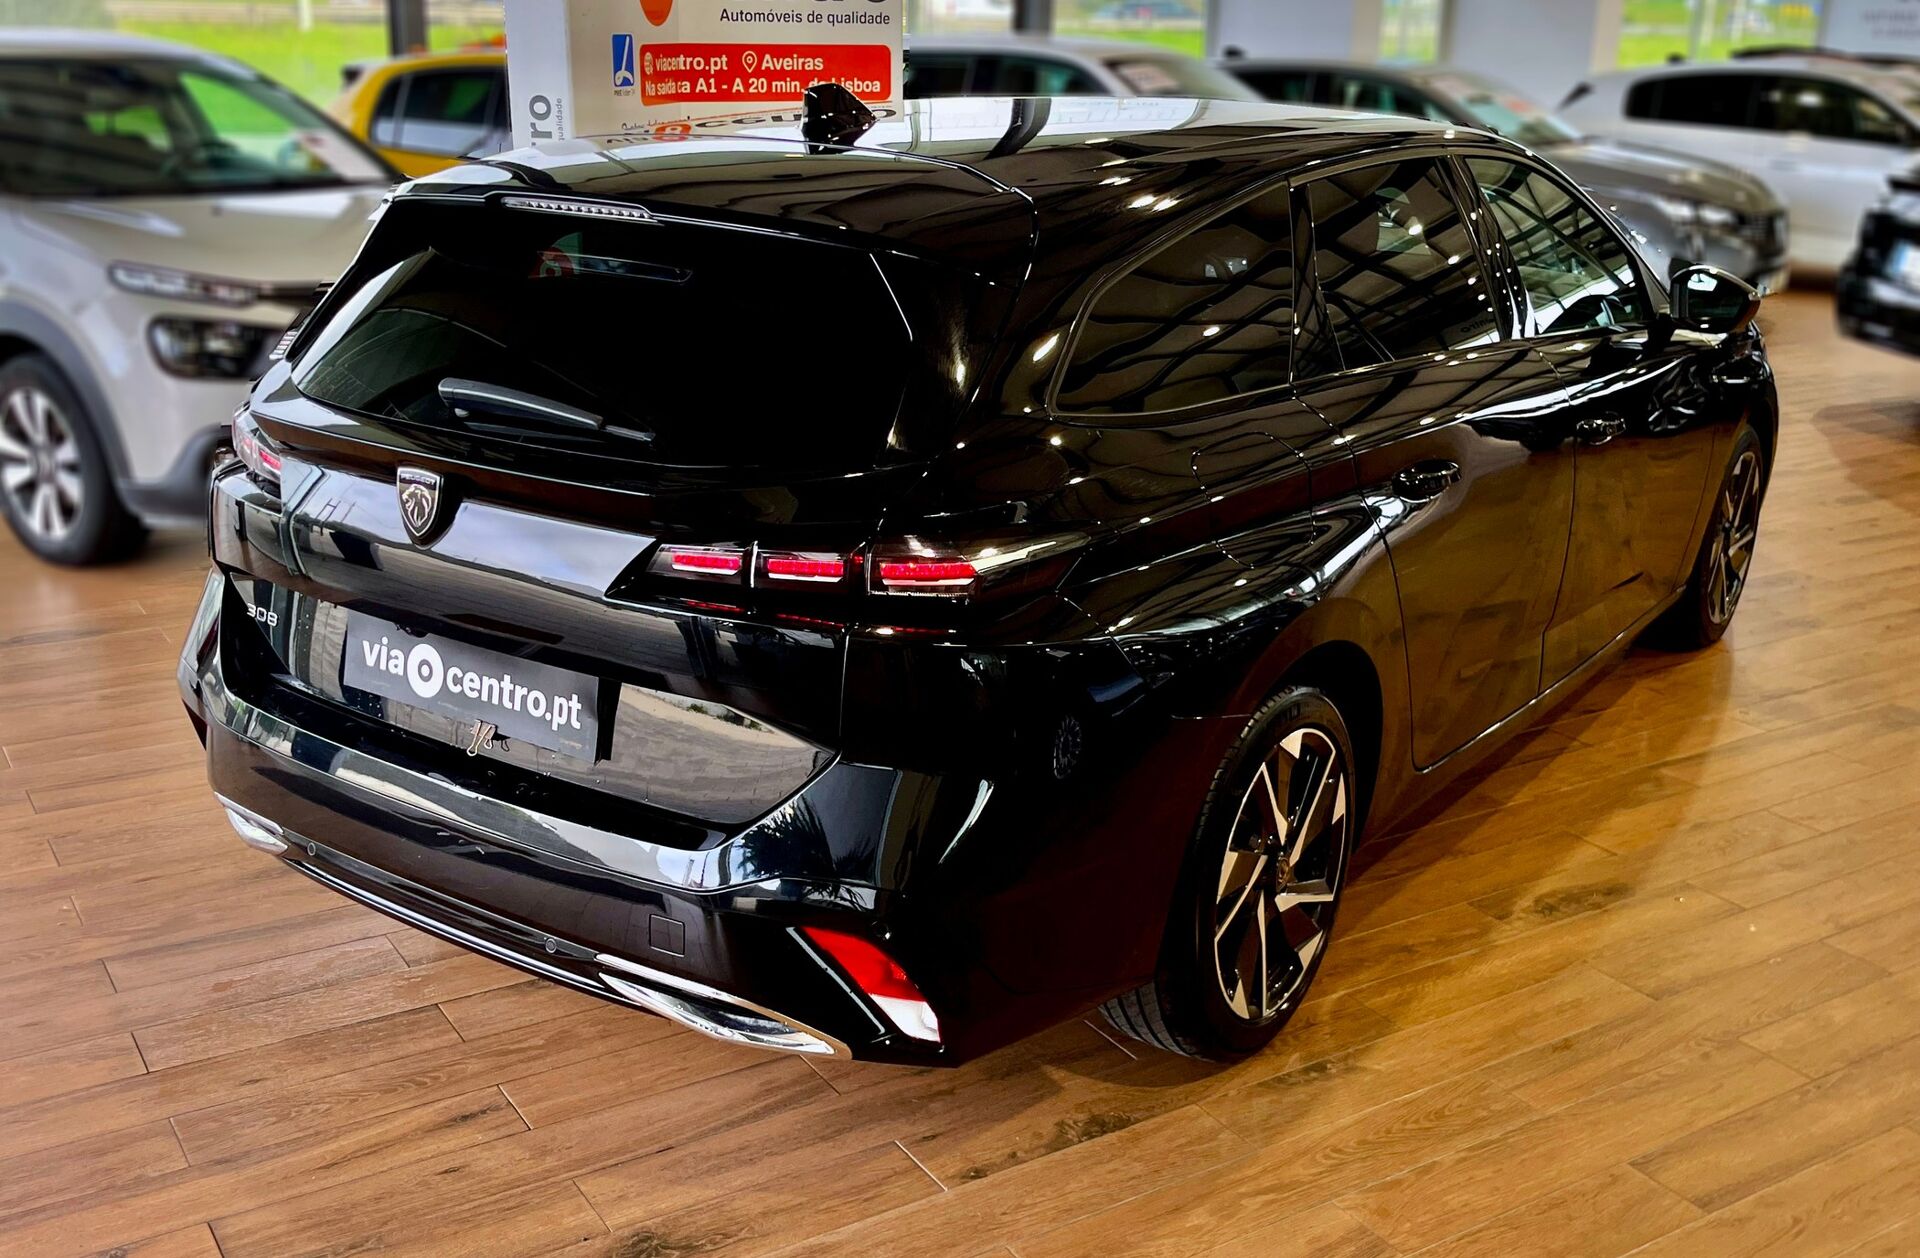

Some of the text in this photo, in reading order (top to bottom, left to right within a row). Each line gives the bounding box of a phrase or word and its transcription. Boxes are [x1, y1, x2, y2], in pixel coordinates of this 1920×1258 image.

[720, 8, 891, 27] Automóveis de qualidade
[761, 54, 824, 71] Aveiras
[645, 81, 655, 96] Na
[695, 78, 717, 93] A1
[732, 78, 744, 93] A
[748, 78, 767, 93] 20
[772, 78, 806, 93] min.
[400, 473, 435, 486] PEUGEOT
[246, 602, 278, 627] 308
